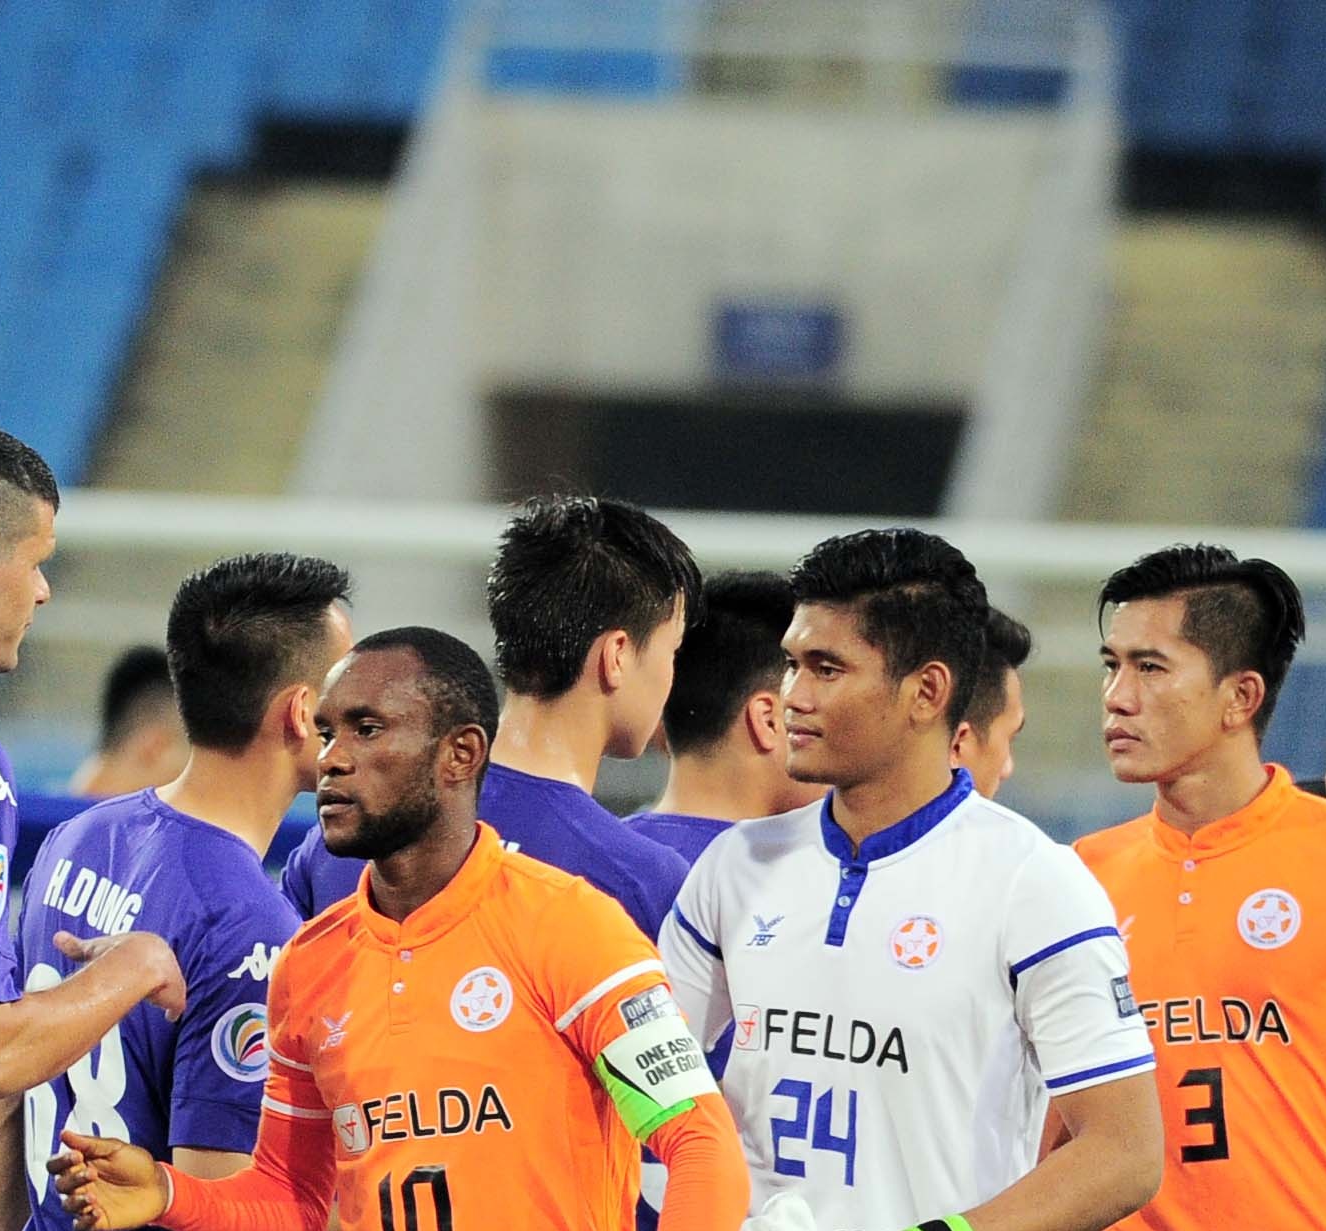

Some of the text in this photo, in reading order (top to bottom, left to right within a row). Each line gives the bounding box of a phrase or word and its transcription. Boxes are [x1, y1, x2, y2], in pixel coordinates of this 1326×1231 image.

[43, 858, 143, 934] H.DUNG
[635, 1043, 670, 1070] ONE
[645, 1058, 679, 1086] ONE
[765, 1008, 909, 1074] FELDA
[361, 1085, 512, 1147] FELDA
[770, 1078, 857, 1187] 24
[1177, 1067, 1229, 1164] 3
